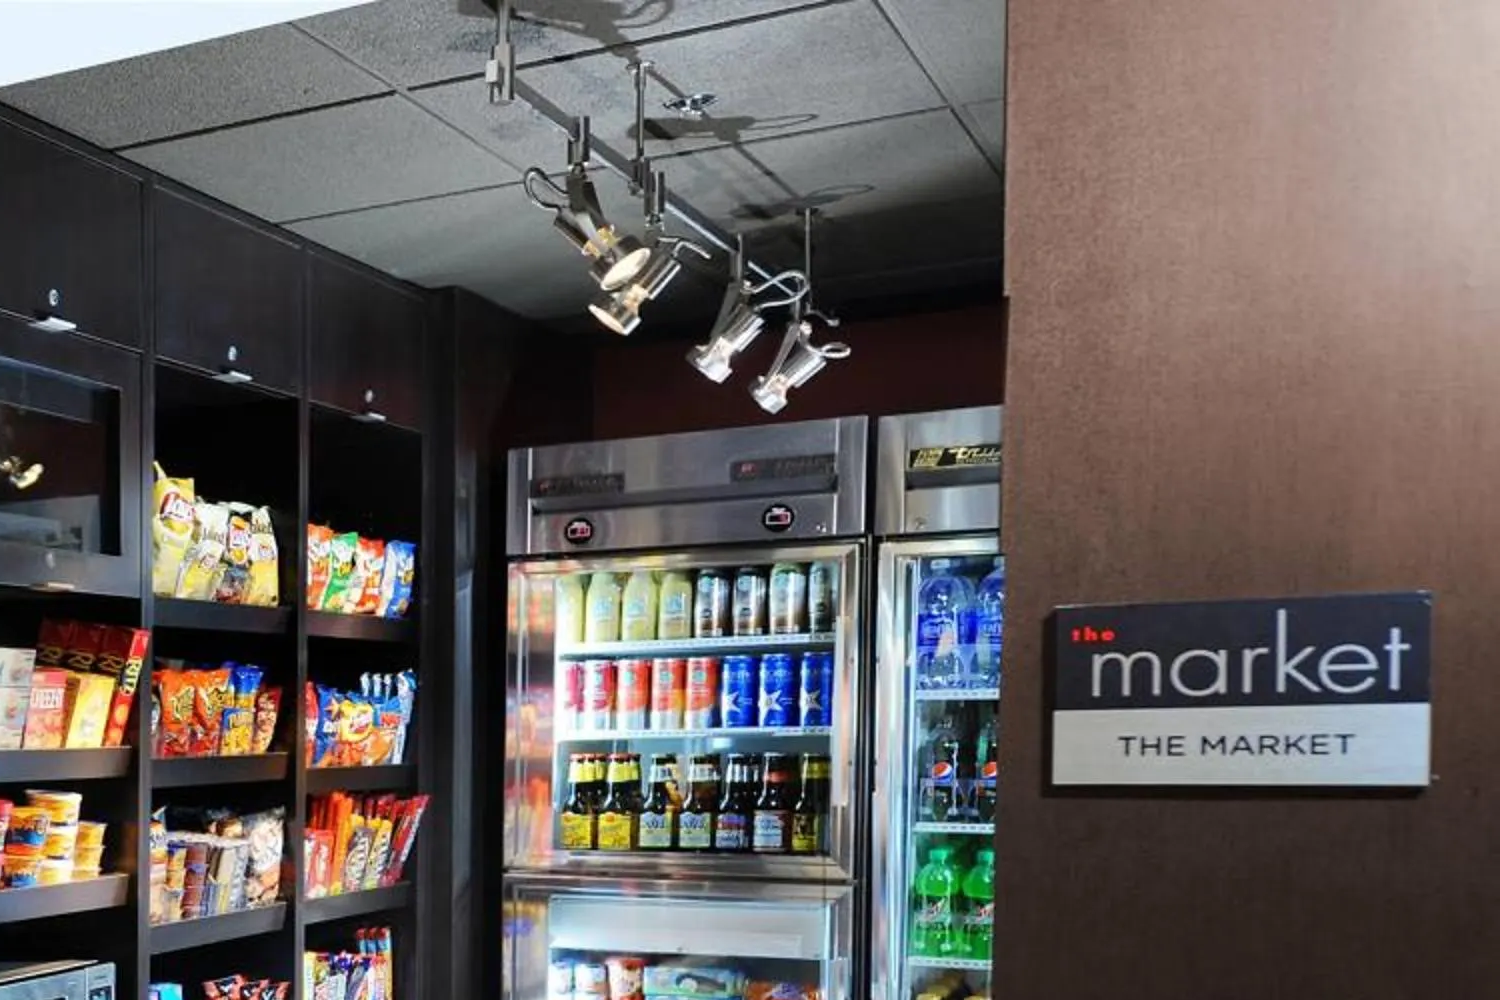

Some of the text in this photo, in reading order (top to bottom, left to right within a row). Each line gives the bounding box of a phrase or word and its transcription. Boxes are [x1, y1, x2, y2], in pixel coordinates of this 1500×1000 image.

[1070, 627, 1116, 643] the
[1091, 608, 1411, 698] market
[1117, 733, 1357, 757] THE MARKET
